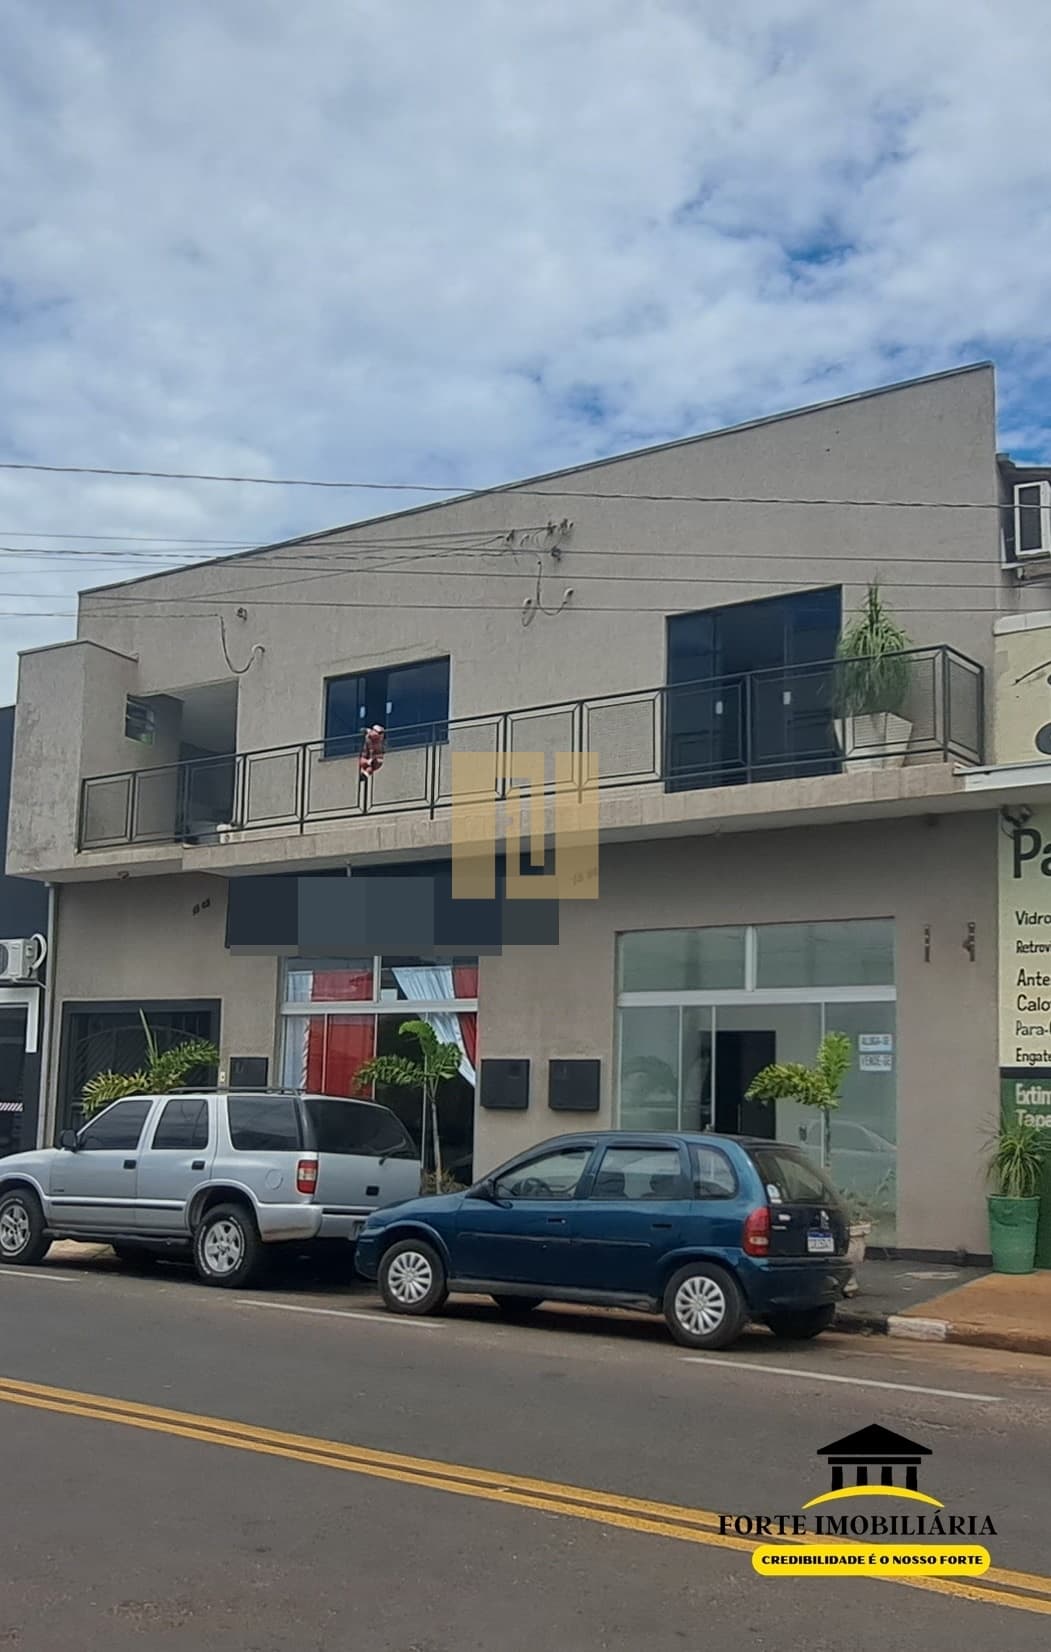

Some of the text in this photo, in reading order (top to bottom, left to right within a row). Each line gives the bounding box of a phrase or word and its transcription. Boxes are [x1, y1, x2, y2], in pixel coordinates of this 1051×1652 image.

[1015, 940, 1051, 953] Retrov
[1017, 994, 1051, 1011] Calo
[1015, 1020, 1051, 1036] Para-
